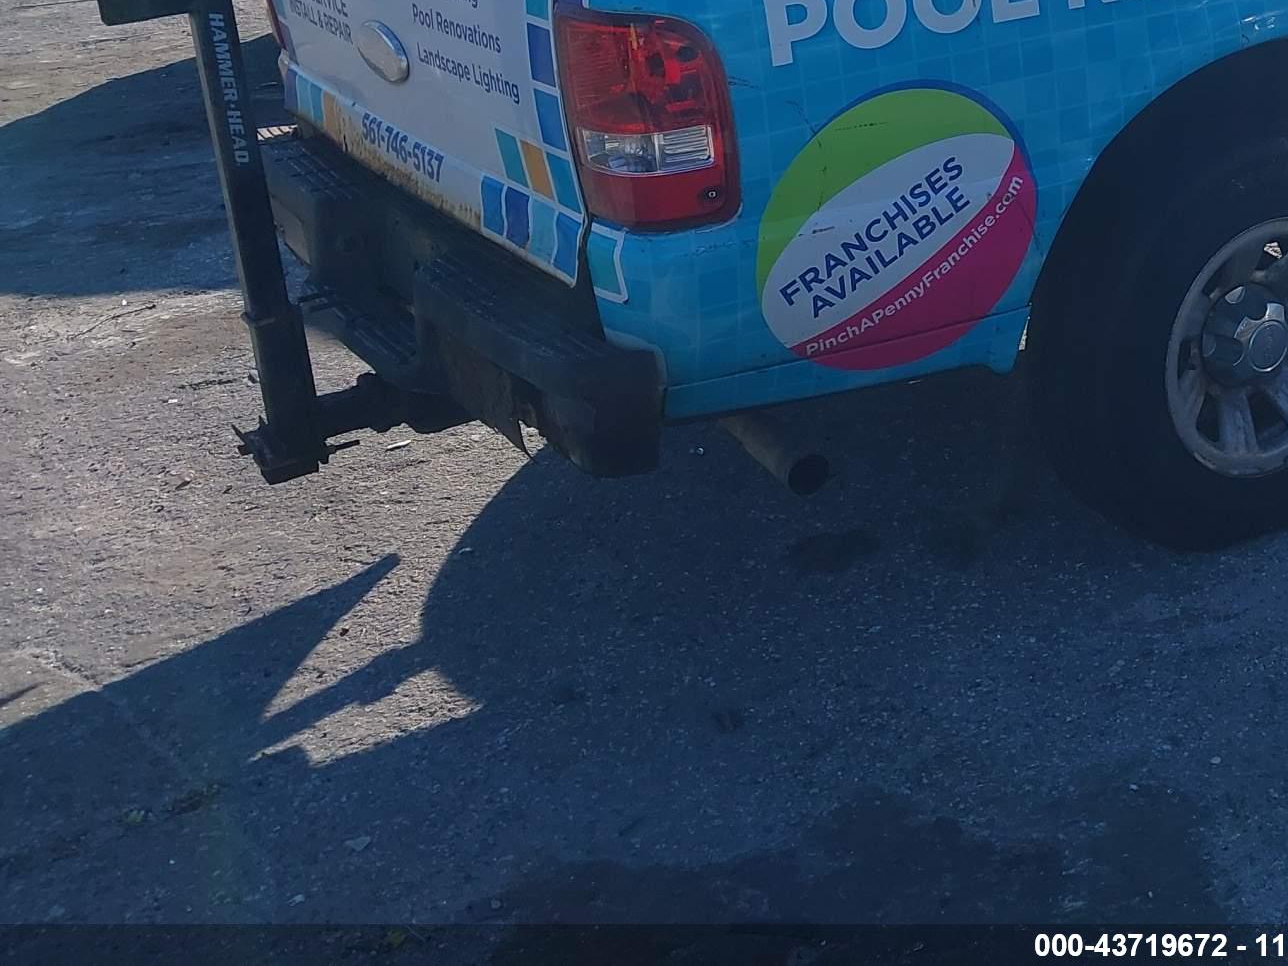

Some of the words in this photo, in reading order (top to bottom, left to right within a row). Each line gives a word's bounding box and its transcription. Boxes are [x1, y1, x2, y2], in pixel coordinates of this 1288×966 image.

[323, 13, 354, 45] REPAIR
[412, 3, 434, 30] Pool
[435, 11, 502, 54] Renovations
[416, 42, 471, 83] Landscape
[472, 63, 520, 105] Lighting
[361, 112, 445, 183] 561-746-5137
[778, 156, 964, 307] FRANCHISES
[805, 175, 1024, 356] PinchAPennyFranchise.com
[809, 186, 970, 318] AVAILABLE
